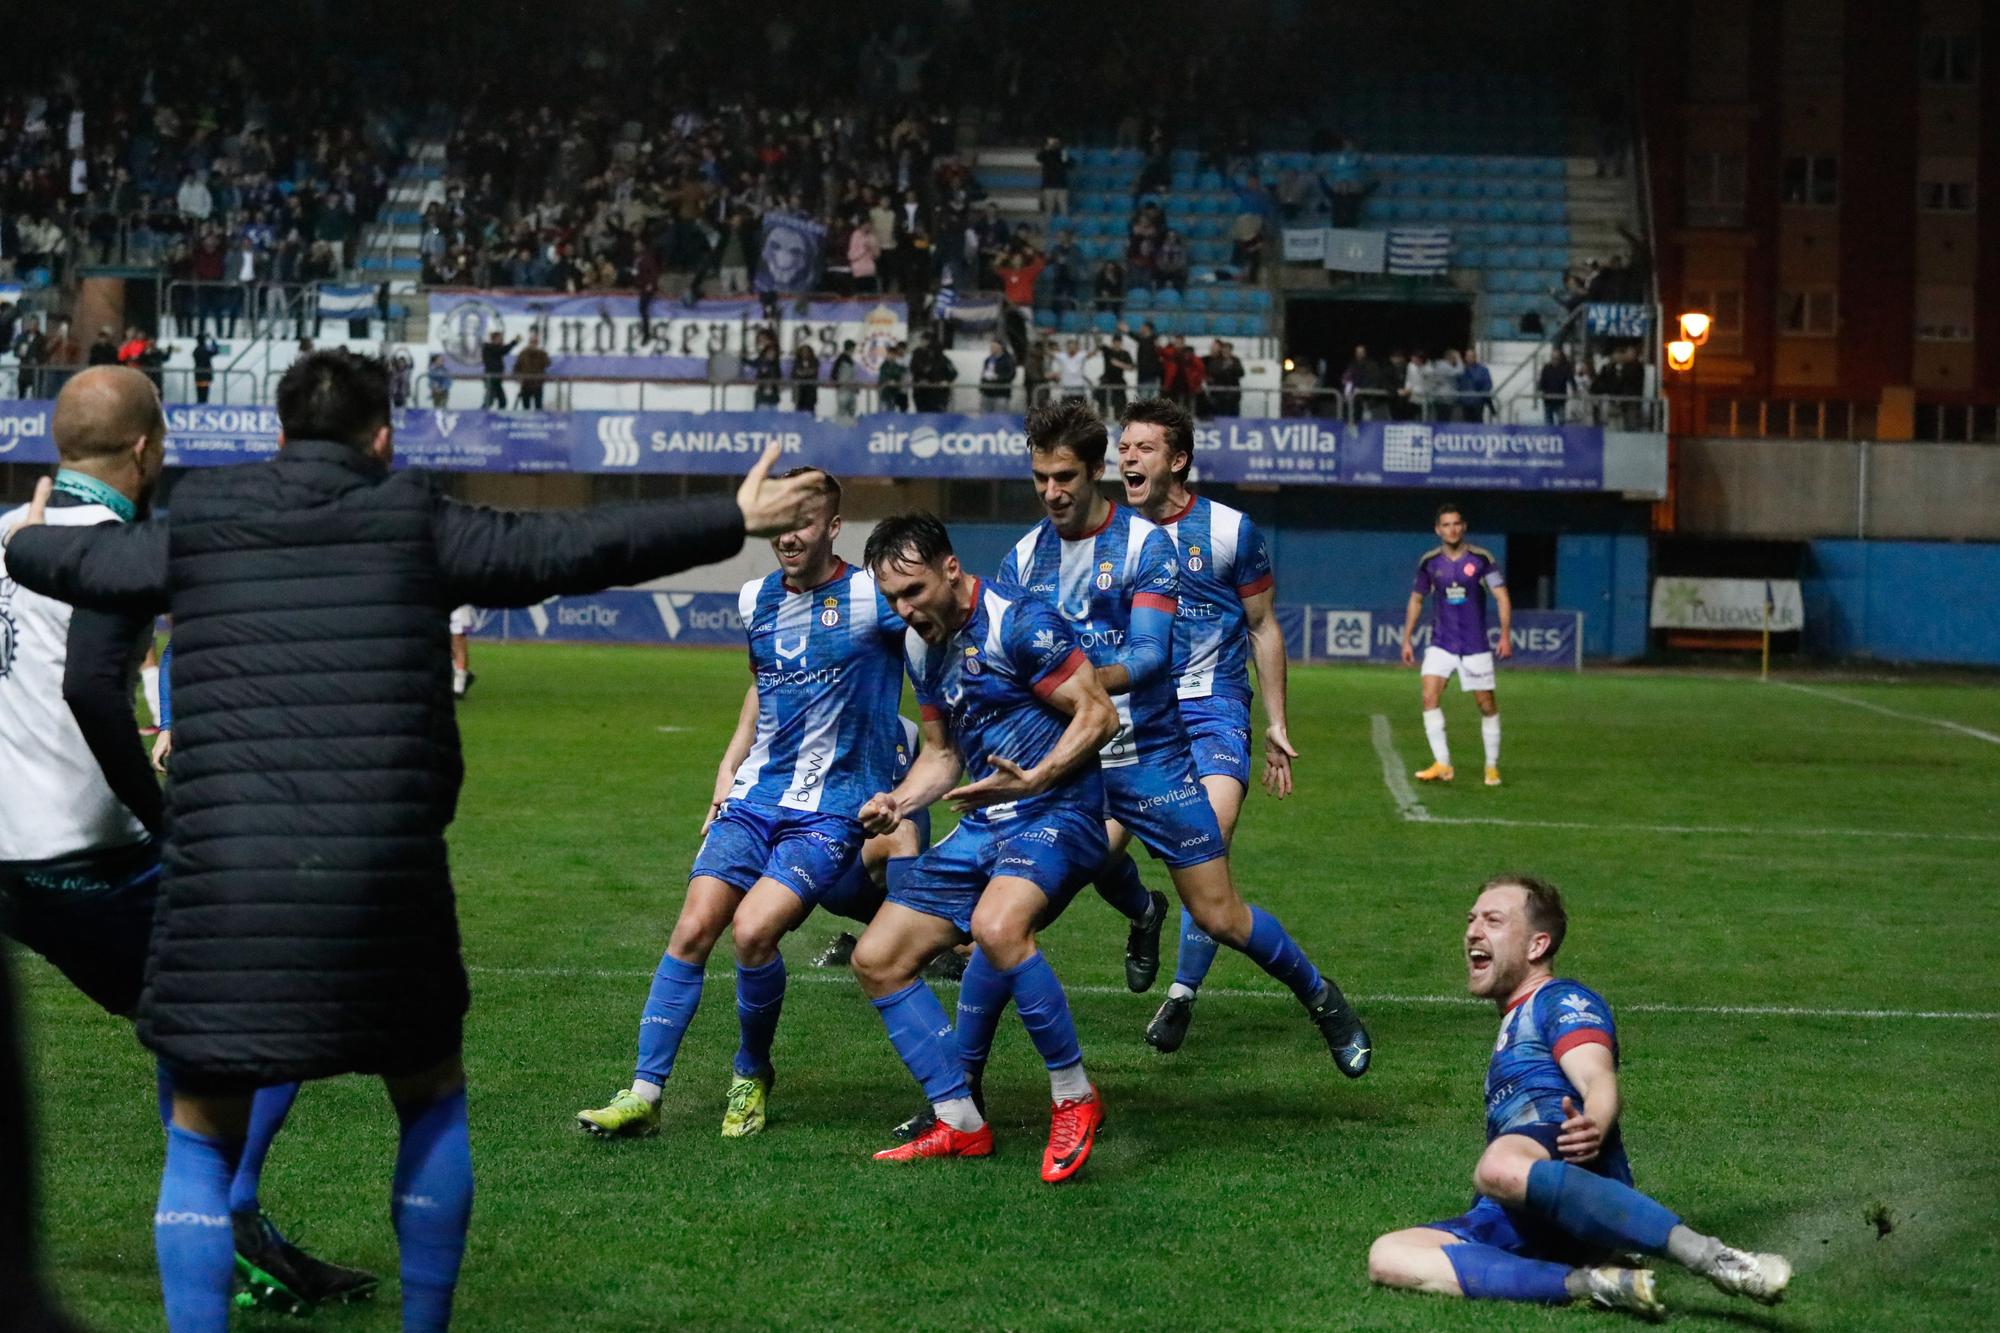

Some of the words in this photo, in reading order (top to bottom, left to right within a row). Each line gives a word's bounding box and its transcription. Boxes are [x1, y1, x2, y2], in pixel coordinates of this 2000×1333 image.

[526, 302, 838, 358] Indeseabes
[0, 412, 45, 437] nal
[651, 431, 802, 453] SANIASTUR
[941, 428, 1030, 456] conte
[1193, 428, 1222, 450] es
[1230, 425, 1263, 452] La
[1270, 425, 1336, 453] Villa
[1434, 432, 1564, 459] europreven
[689, 607, 744, 630] tecno
[1138, 784, 1198, 812] previtalia
[1180, 833, 1210, 848] NOONE
[1186, 933, 1214, 945] NOO
